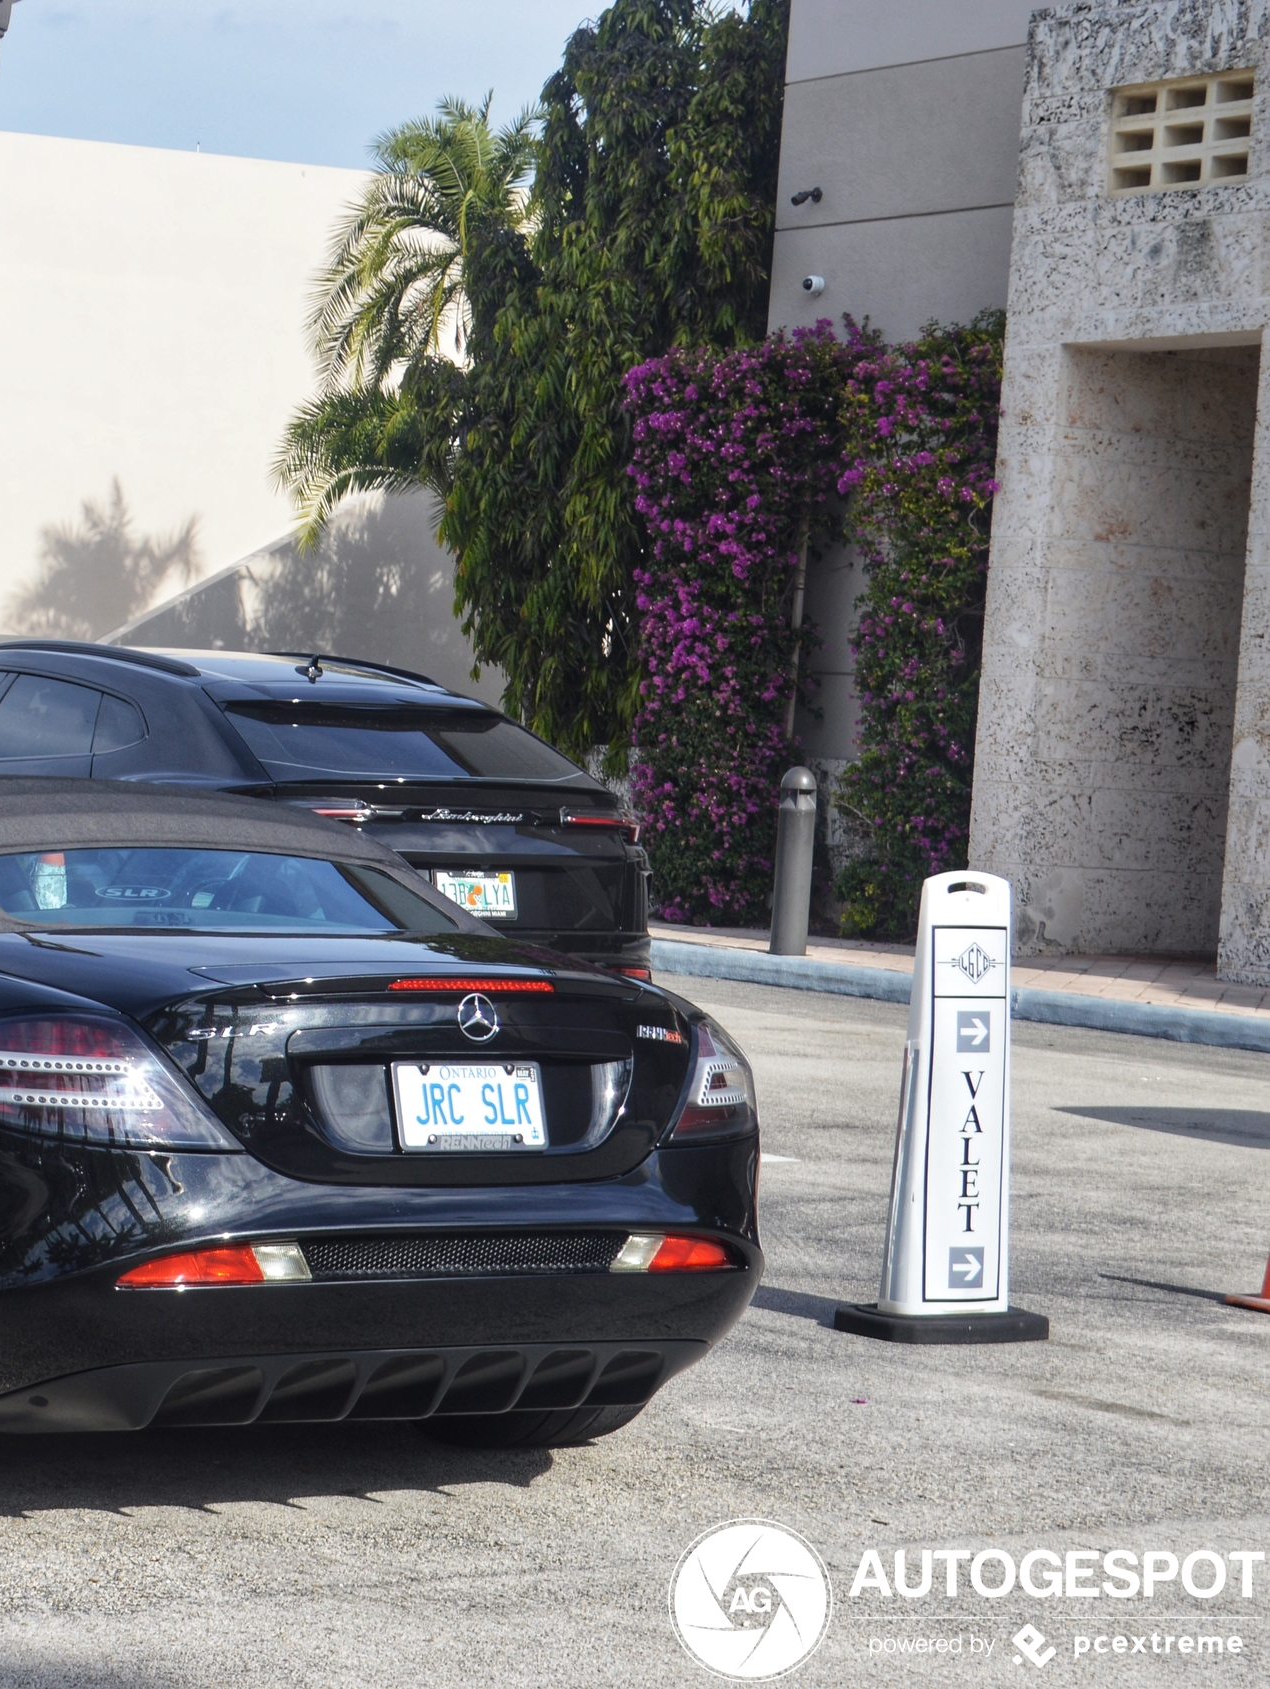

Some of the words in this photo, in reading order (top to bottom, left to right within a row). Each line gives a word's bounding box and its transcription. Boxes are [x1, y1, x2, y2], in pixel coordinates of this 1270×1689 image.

[105, 888, 158, 897] SLR
[187, 1022, 278, 1041] SLR
[439, 1065, 497, 1080] ONTARIO
[416, 1083, 464, 1125] JRC
[481, 1083, 532, 1125] SLR
[440, 1136, 511, 1150] RENNtech
[957, 1070, 985, 1232] VALET
